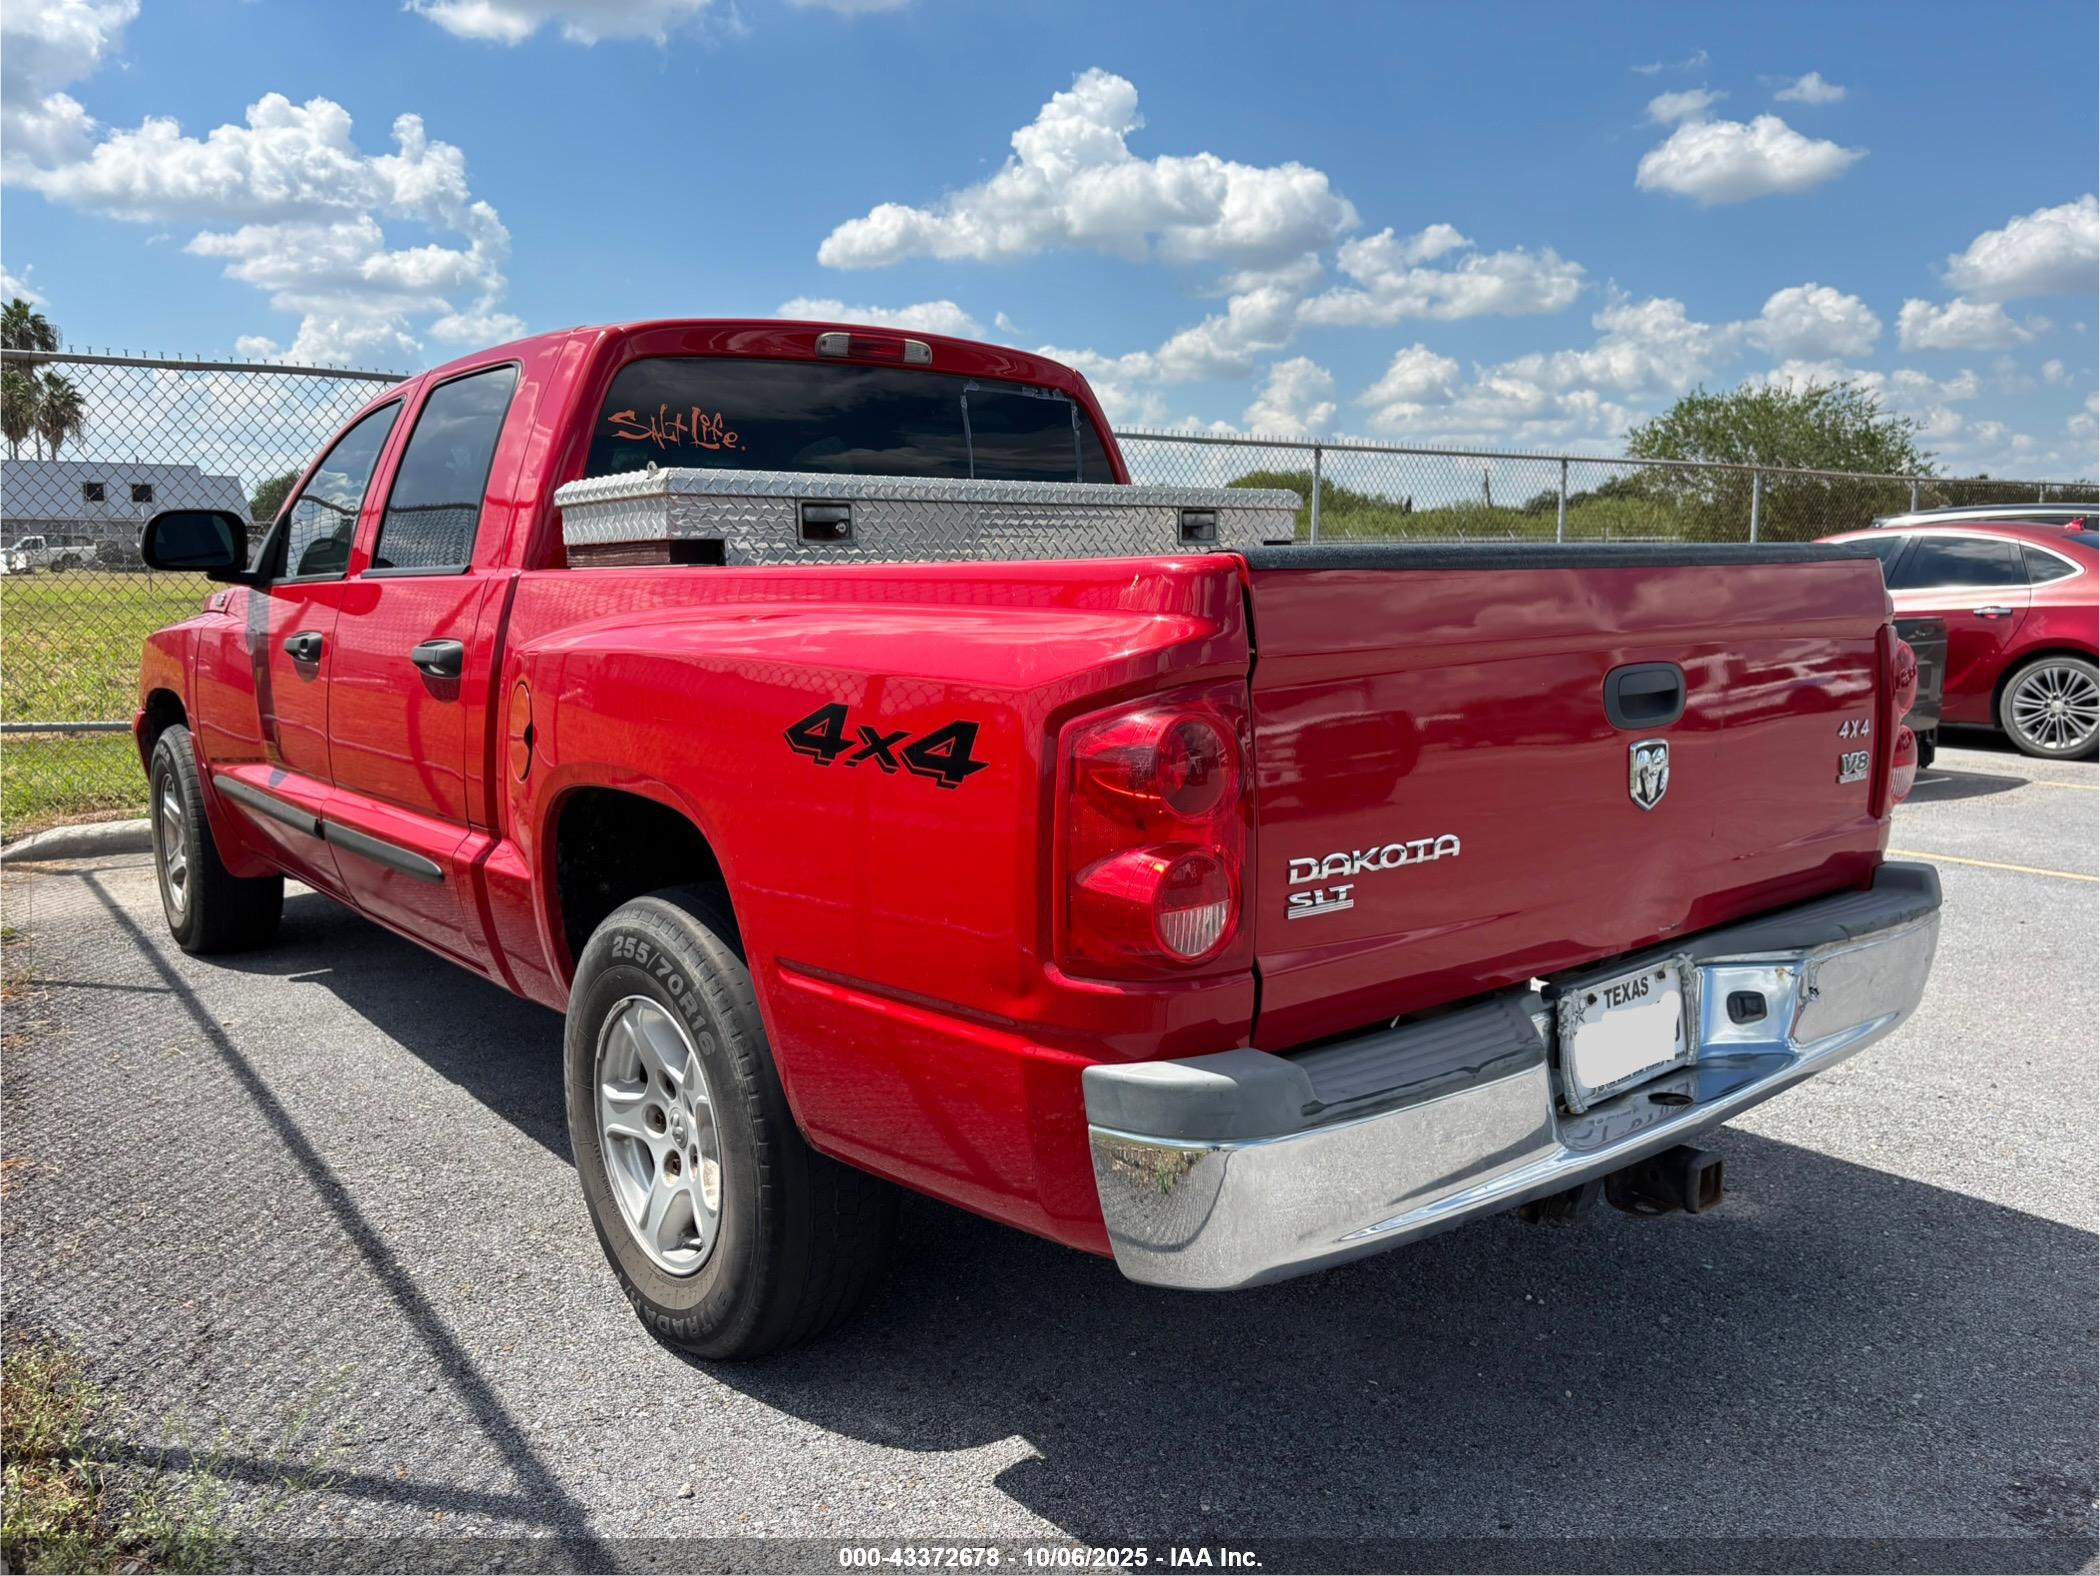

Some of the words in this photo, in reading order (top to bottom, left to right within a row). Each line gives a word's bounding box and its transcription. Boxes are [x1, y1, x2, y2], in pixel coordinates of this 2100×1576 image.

[1841, 750, 1870, 775] V8
[1288, 834, 1461, 885] DAKOTA
[1289, 884, 1355, 908] SLT
[612, 935, 716, 1056] 255/70R16
[1603, 975, 1649, 1009] TEXAS
